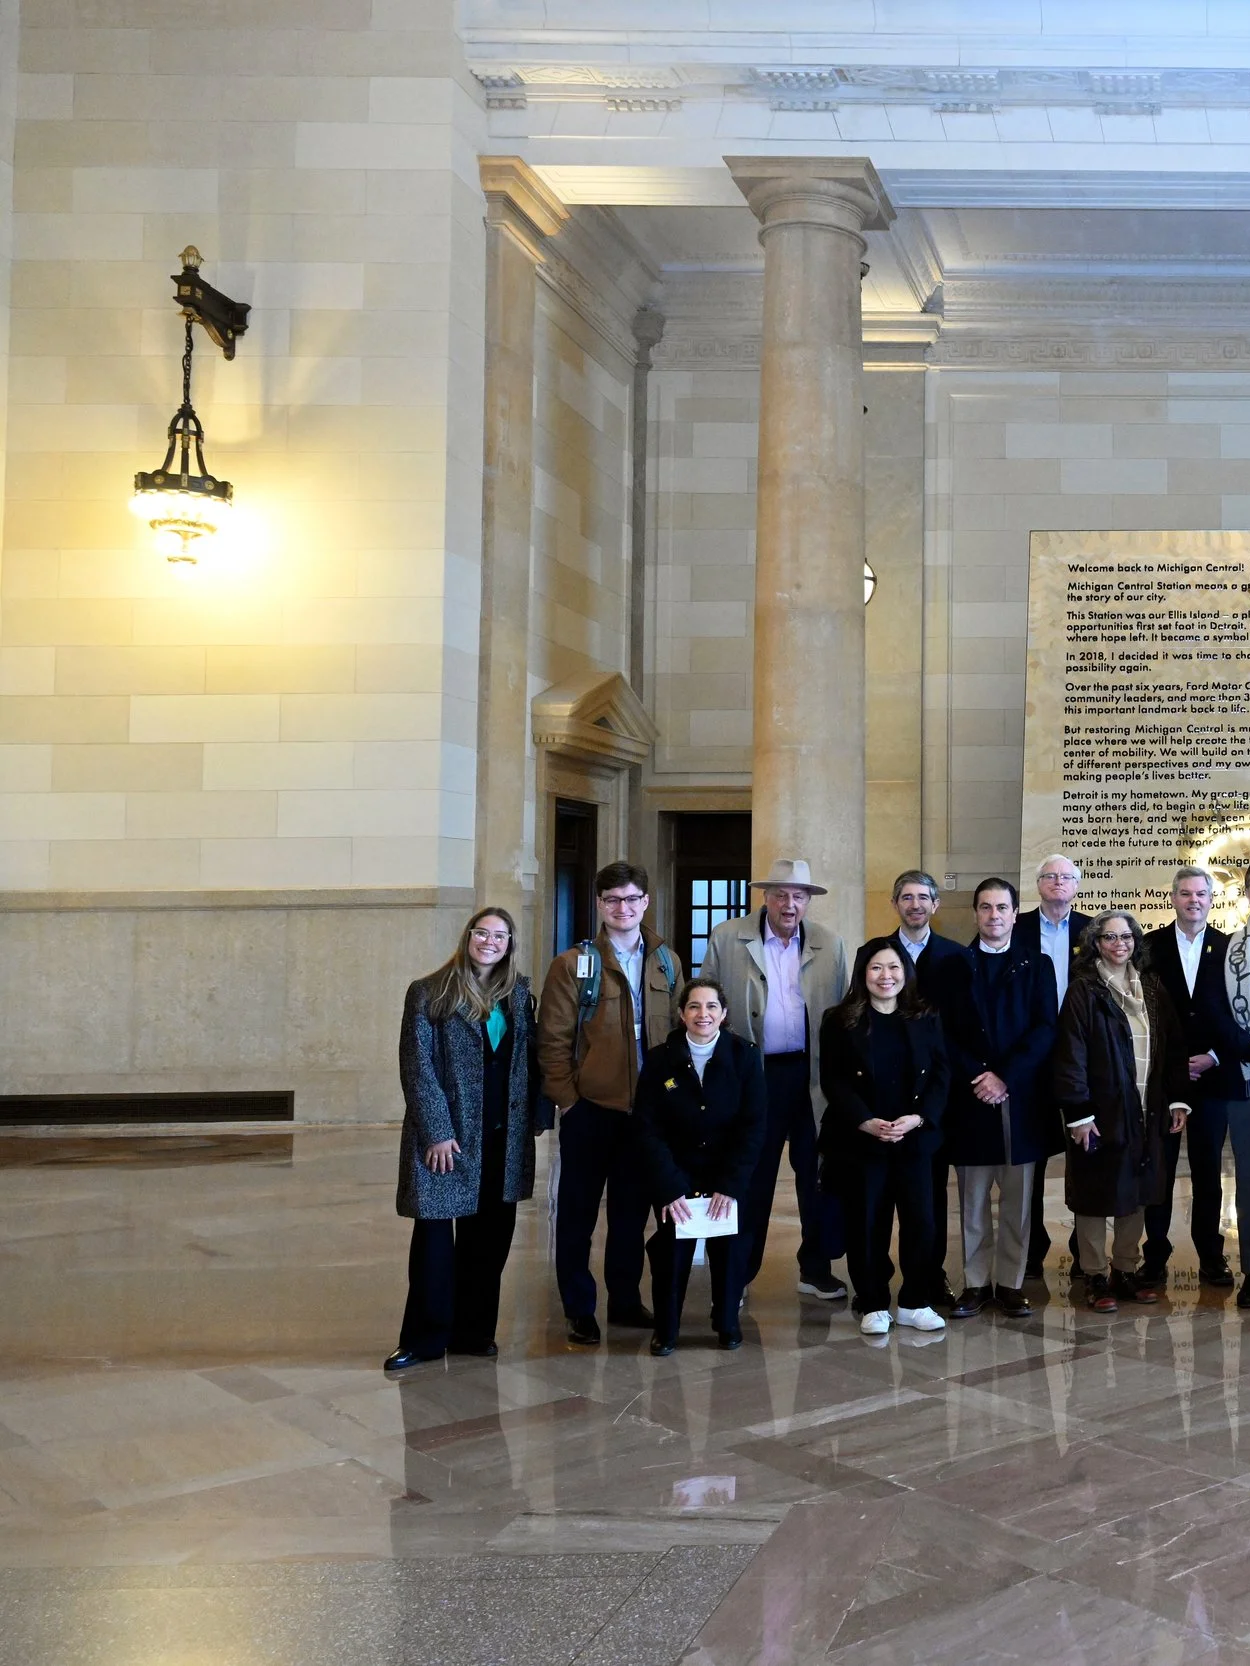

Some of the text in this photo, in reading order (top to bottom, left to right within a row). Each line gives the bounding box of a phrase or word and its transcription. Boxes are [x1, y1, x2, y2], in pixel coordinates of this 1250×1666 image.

[1067, 562, 1244, 574] Welcome back Michigan Central!
[1067, 581, 1113, 593] Michigan
[1117, 581, 1153, 590] Central
[1156, 581, 1191, 590] Station
[1084, 592, 1168, 604] story city.
[1066, 610, 1085, 620] This
[1087, 610, 1122, 620] Station
[1168, 610, 1187, 619] Ellis
[1189, 610, 1220, 619] Island
[1066, 621, 1133, 633] opportunities
[1136, 621, 1155, 631] first
[1174, 621, 1194, 631] foot
[1209, 621, 1246, 630] Detroit.
[1066, 632, 1098, 642] where
[1100, 632, 1126, 644] hope
[1129, 632, 1148, 642] left.
[1160, 632, 1202, 642] became
[1212, 632, 1249, 644] symbol
[1079, 651, 1106, 662] 2018,
[1118, 651, 1158, 660] decided
[1196, 651, 1218, 660] time
[1065, 662, 1151, 674] possibility again.
[1065, 682, 1091, 691] Over
[1111, 682, 1133, 693] past
[1152, 684, 1183, 693] years,
[1186, 681, 1208, 691] Ford
[1211, 681, 1242, 691] Motor
[1064, 693, 1121, 705] community
[1123, 693, 1164, 704] leaders,
[1218, 693, 1241, 702] than
[1064, 704, 1249, 716] this important landmark back life.
[1084, 724, 1130, 736] restoring
[1134, 724, 1182, 736] Michigan
[1063, 736, 1091, 748] place
[1094, 736, 1127, 745] where
[1148, 736, 1167, 745] will
[1170, 736, 1192, 747] help
[1195, 736, 1227, 745] create
[1063, 748, 1095, 757] center
[1112, 747, 1156, 759] mobility.
[1180, 747, 1199, 757] will
[1202, 747, 1227, 756] build
[1076, 759, 1121, 769] different
[1124, 759, 1188, 771] perspectives
[1063, 771, 1211, 783] making lives better.
[1063, 789, 1098, 799] Detroit
[1130, 789, 1188, 799] hometown.
[1063, 804, 1091, 814] many
[1095, 802, 1126, 811] others
[1166, 801, 1195, 813] begin
[1088, 814, 1112, 823] born
[1117, 814, 1142, 824] here,
[1062, 826, 1087, 835] have
[1091, 826, 1129, 837] always
[1081, 838, 1106, 848] cede
[1116, 857, 1141, 868] spirit
[1111, 888, 1141, 898] thank
[1081, 901, 1136, 911] have been
